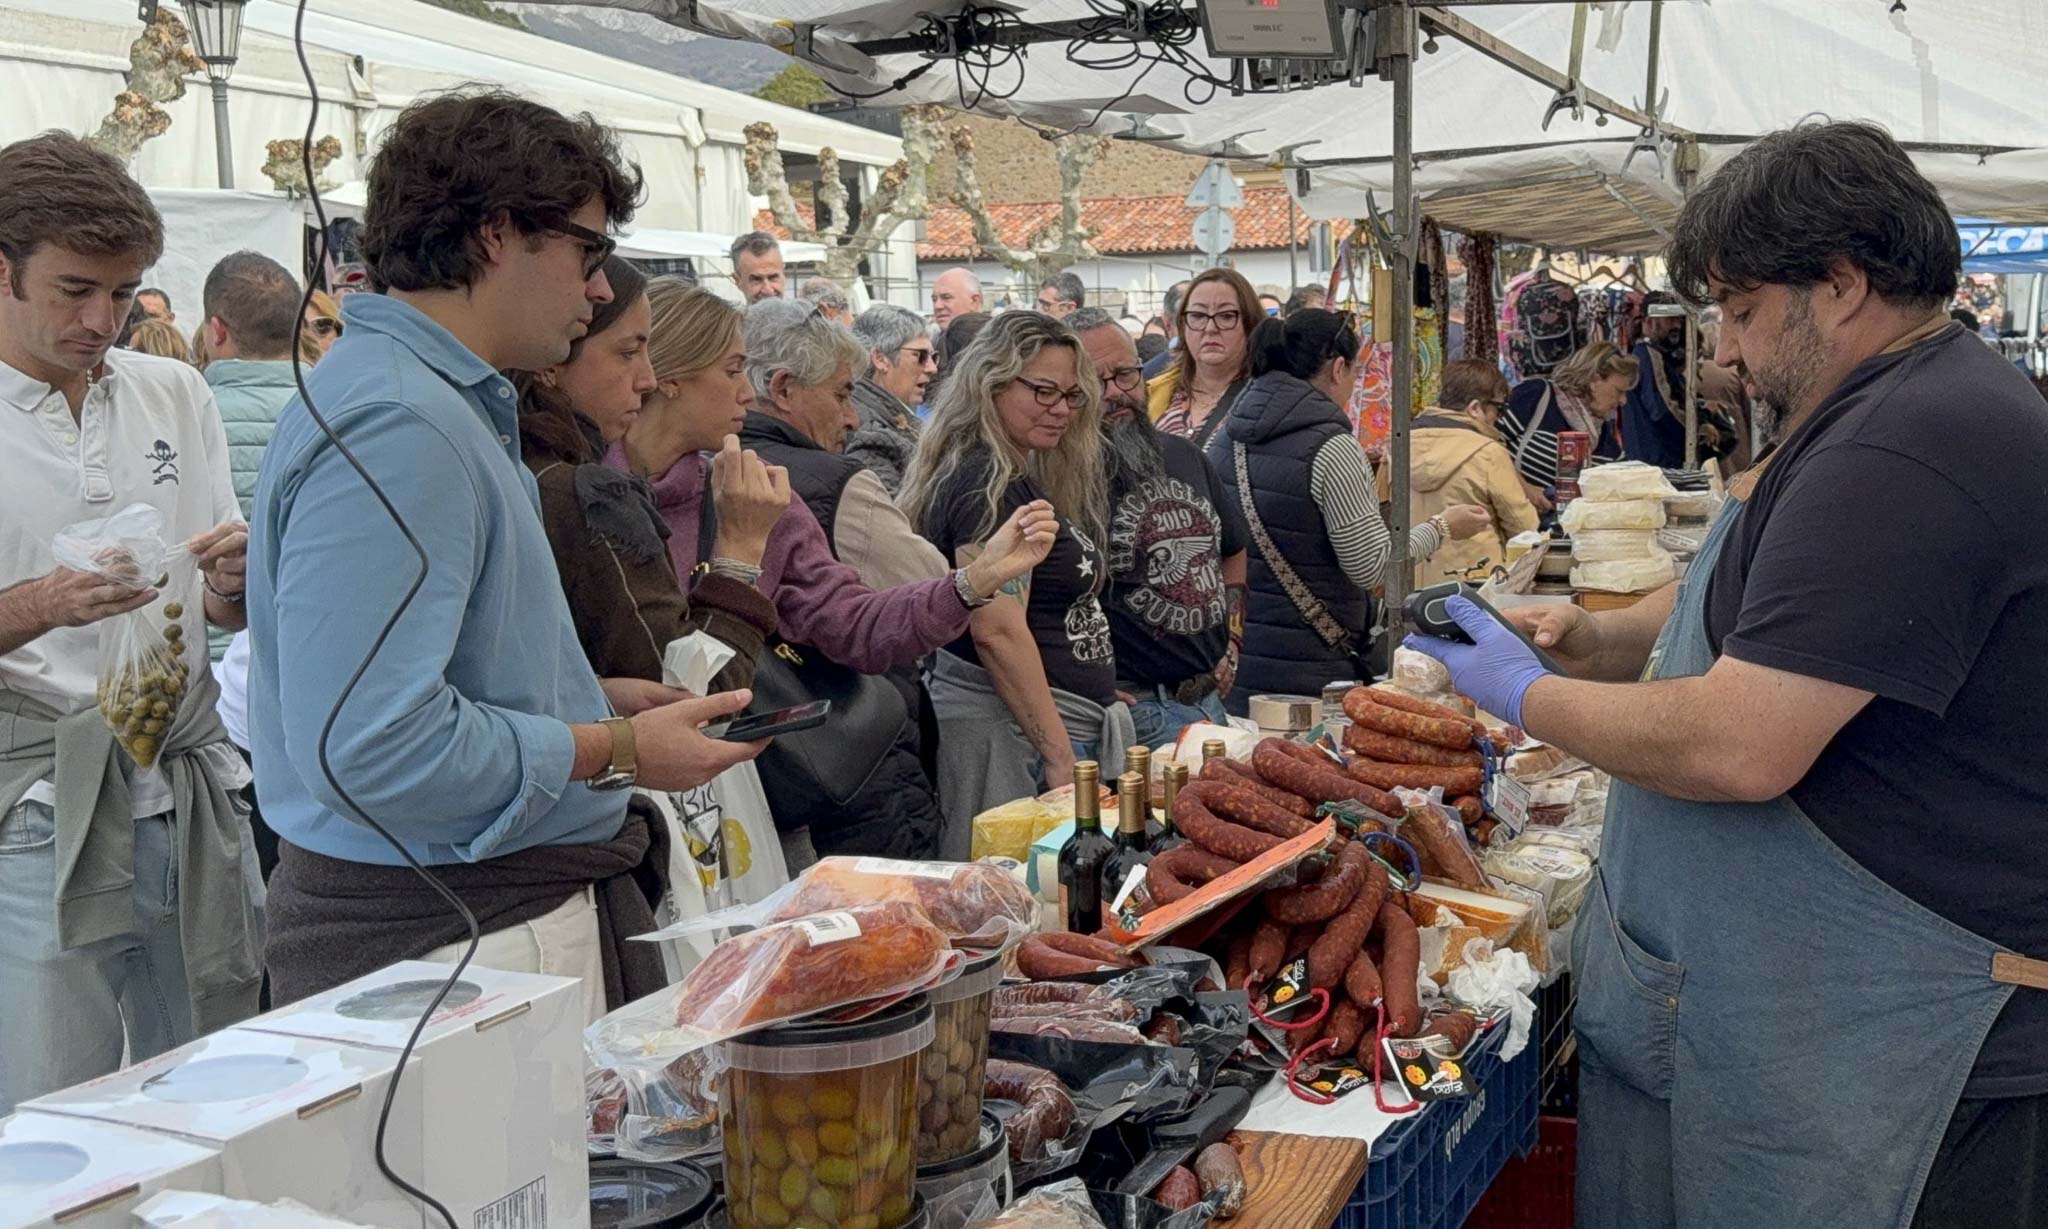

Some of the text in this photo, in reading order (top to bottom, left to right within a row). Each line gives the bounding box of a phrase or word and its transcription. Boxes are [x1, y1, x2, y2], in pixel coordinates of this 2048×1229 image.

[1960, 227, 2048, 256] DECA
[1109, 493, 1146, 573] HAMC
[1153, 508, 1193, 532] 2019
[1125, 586, 1203, 633] EURO
